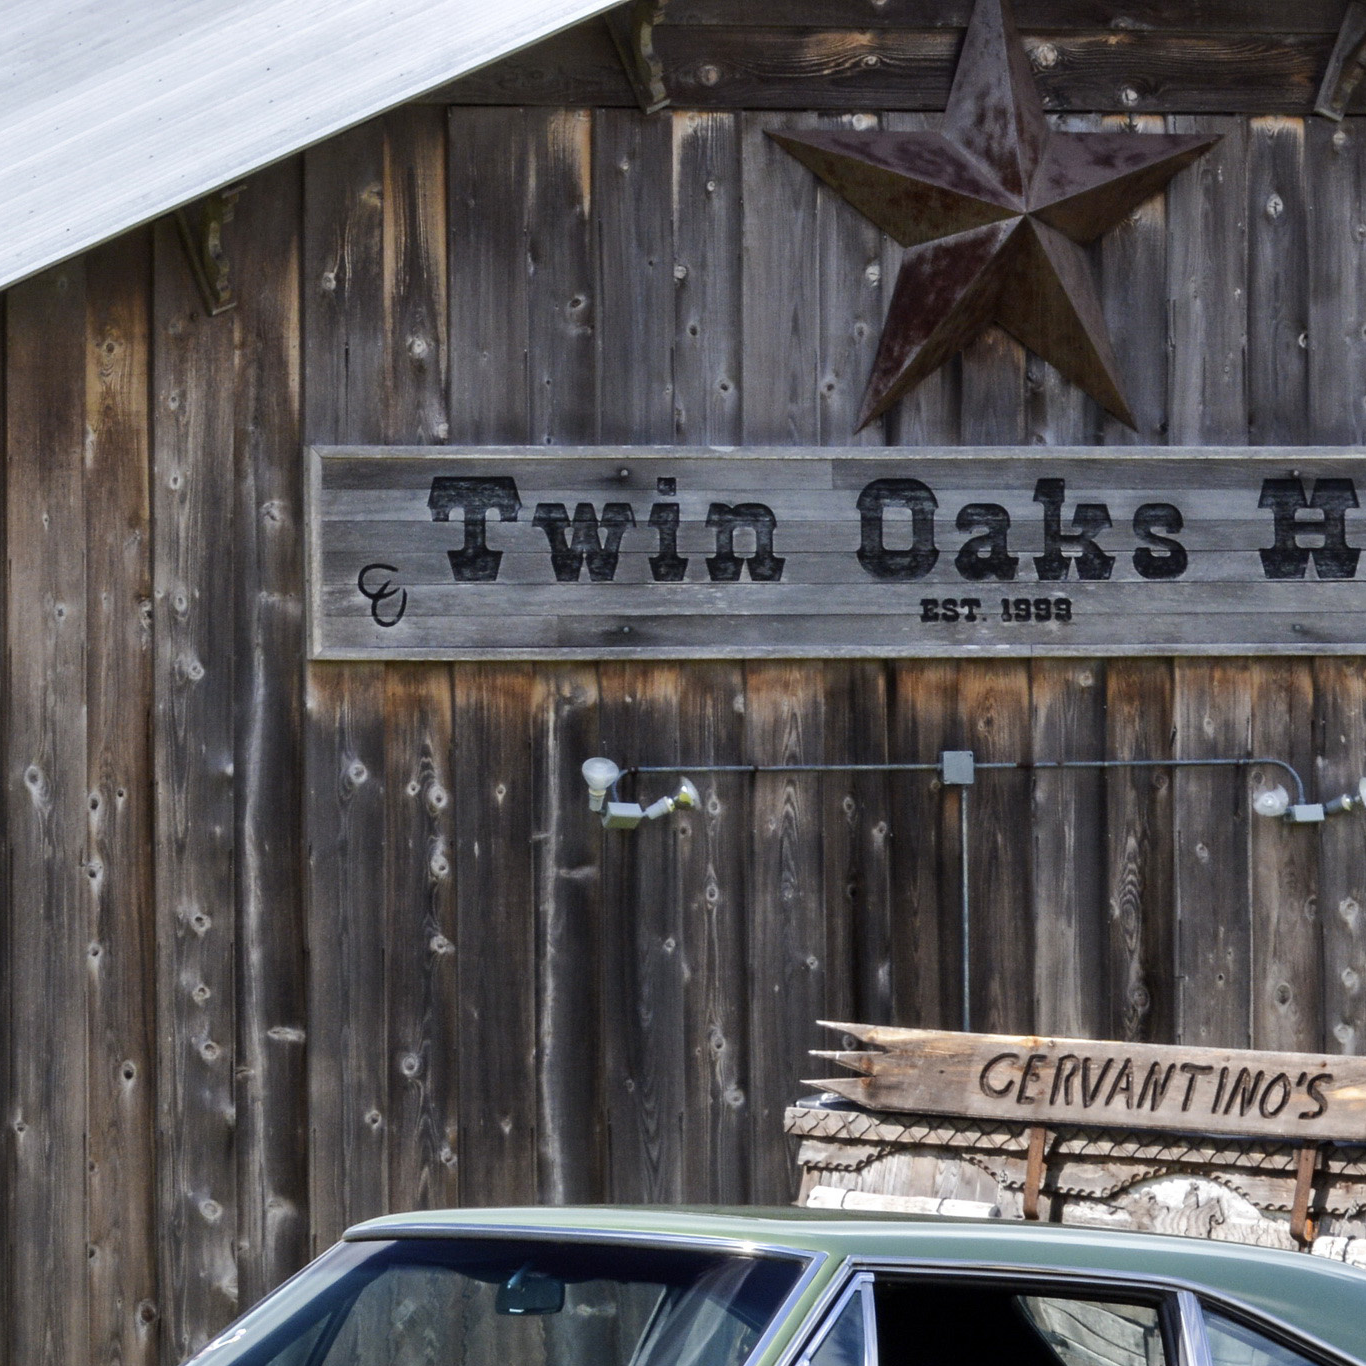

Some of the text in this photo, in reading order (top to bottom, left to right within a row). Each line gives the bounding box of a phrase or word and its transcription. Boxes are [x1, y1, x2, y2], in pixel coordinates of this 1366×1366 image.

[428, 475, 786, 583] Twin
[855, 477, 1188, 582] Oaks
[919, 597, 1073, 622] EST. 1999
[979, 1052, 1334, 1120] CERVANTINO'S
